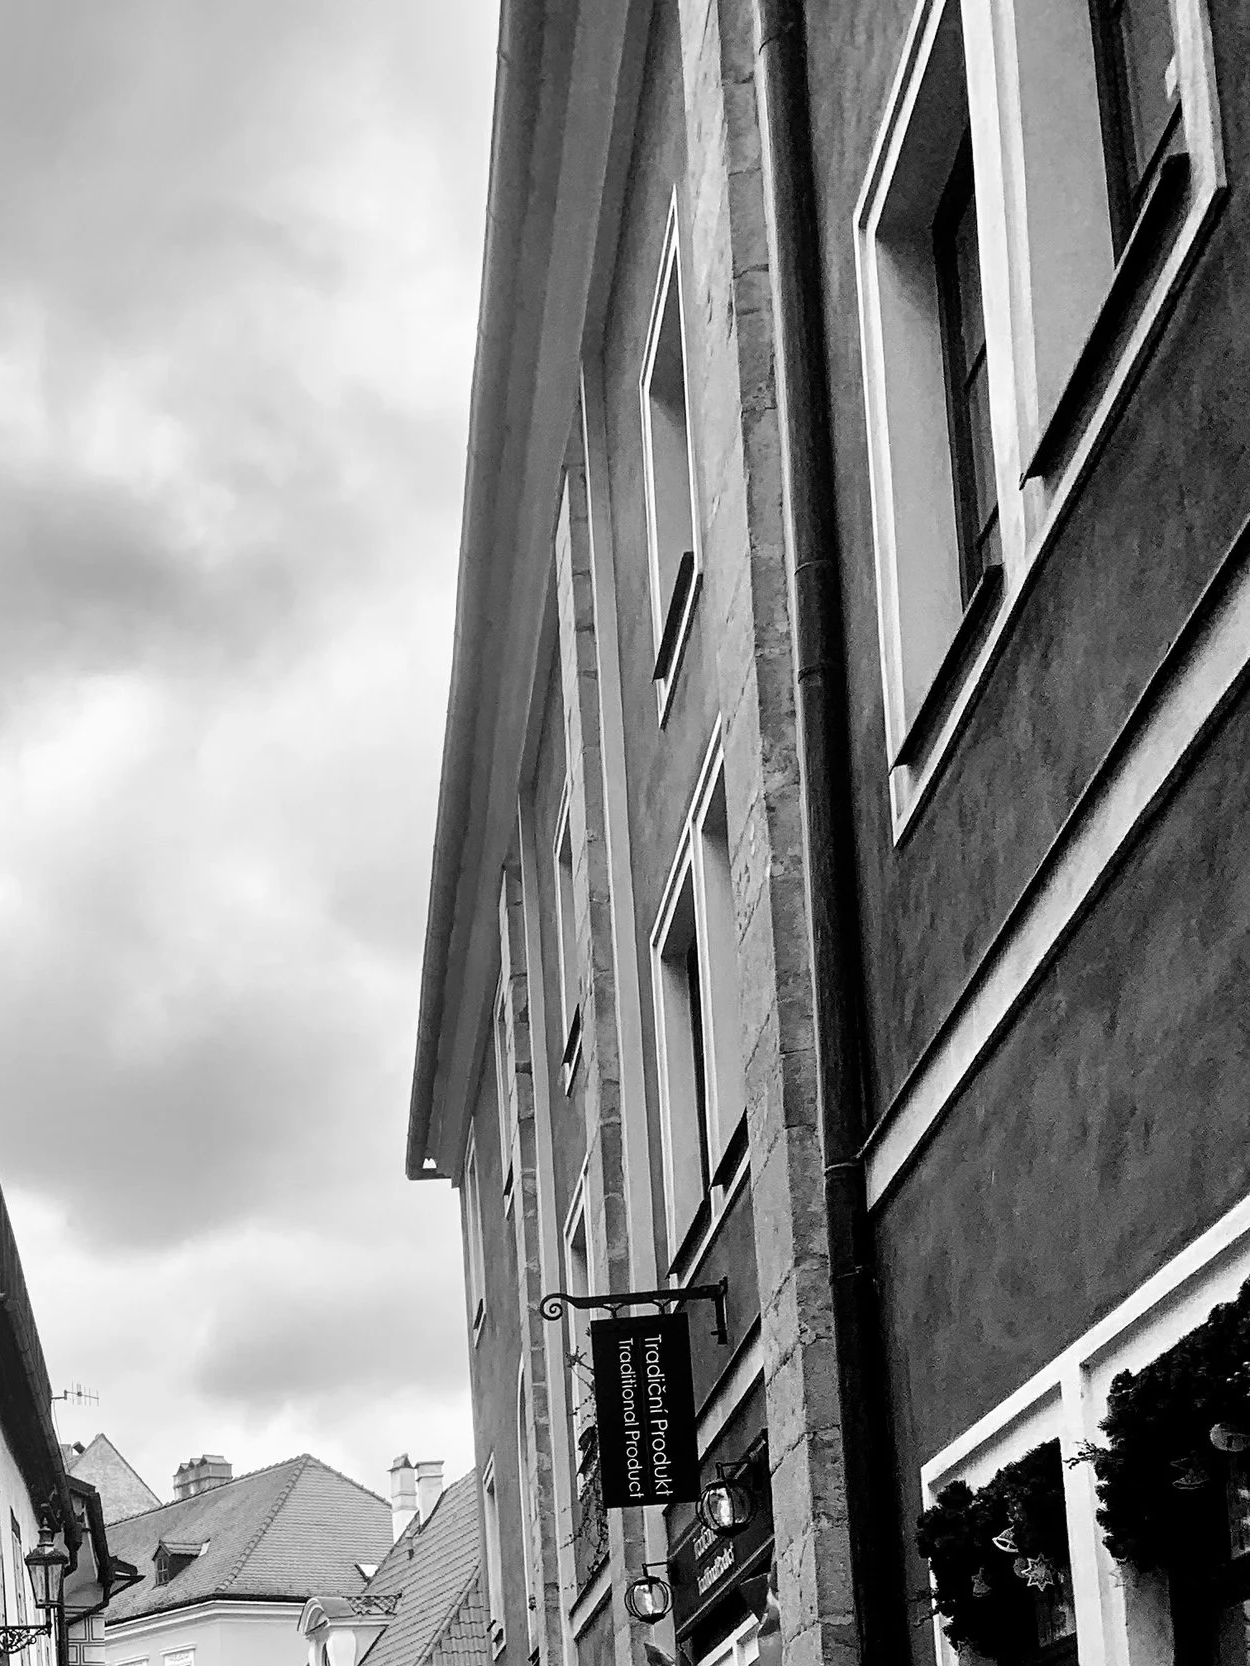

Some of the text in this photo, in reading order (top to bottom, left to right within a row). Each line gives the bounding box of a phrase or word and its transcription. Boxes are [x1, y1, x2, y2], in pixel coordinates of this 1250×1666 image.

[618, 1338, 644, 1498] Traditional Product
[645, 1334, 674, 1496] Tradiční Produkt
